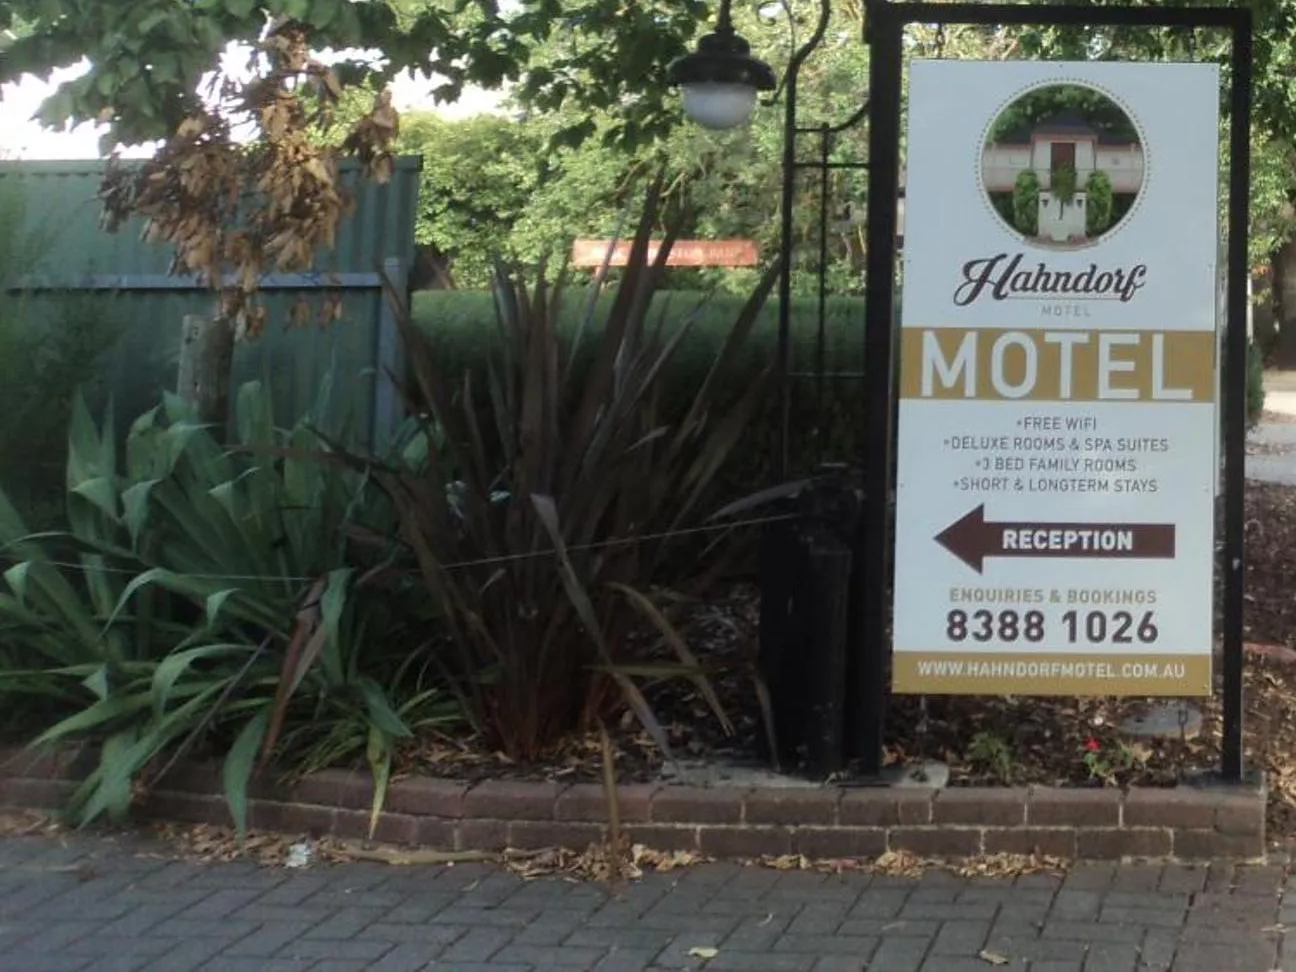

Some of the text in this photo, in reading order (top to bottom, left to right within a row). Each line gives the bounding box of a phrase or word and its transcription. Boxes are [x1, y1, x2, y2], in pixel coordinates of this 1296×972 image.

[953, 253, 1147, 306] Hahndorf
[1041, 305, 1091, 317] MOTEL
[920, 331, 1193, 400] MOTEL
[1066, 417, 1097, 430] WIFI
[1014, 437, 1065, 451] ROOMS
[1069, 438, 1080, 451] &
[1084, 438, 1112, 451] SPA
[1117, 438, 1169, 452] SUITES
[995, 458, 1024, 470] BED
[1029, 458, 1079, 471] FAMILY
[1084, 459, 1137, 472] ROOMS
[1014, 478, 1024, 491] &
[1029, 479, 1109, 492] LONGTERM
[1114, 479, 1158, 492] STAYS
[1002, 529, 1134, 551] RECEPTION
[950, 588, 1157, 604] ENQUIRIES & BOOKINGS
[946, 609, 1159, 643] 8388 1026
[917, 660, 1185, 679] WWW.HAHNDORFMOTEL.COM.AU
